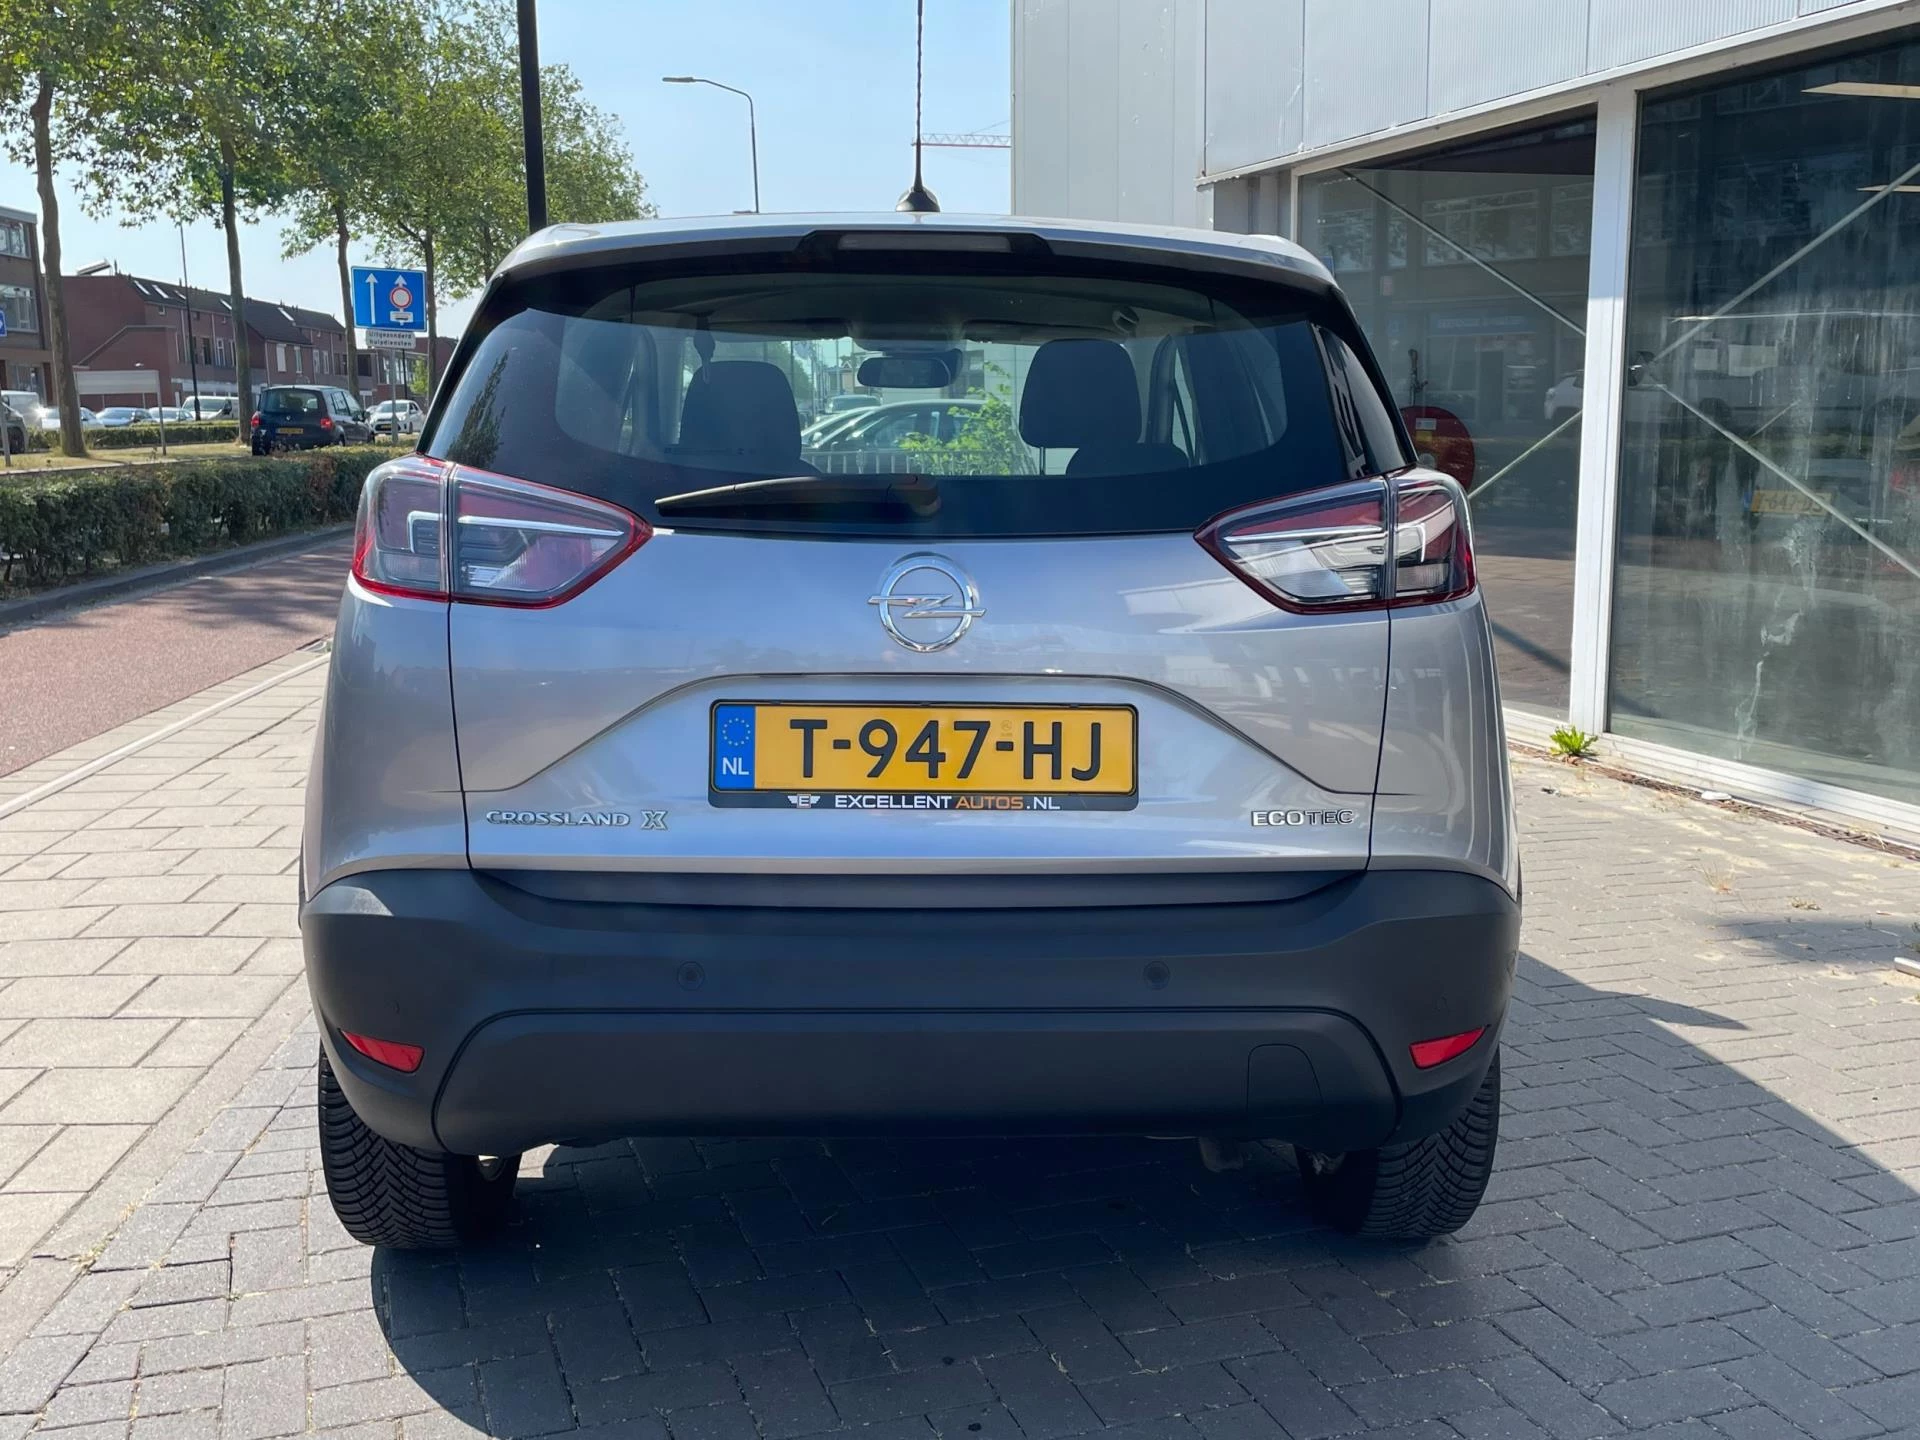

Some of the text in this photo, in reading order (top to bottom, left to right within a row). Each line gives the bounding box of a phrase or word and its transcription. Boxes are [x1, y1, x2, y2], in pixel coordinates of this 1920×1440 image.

[790, 719, 1101, 781] T-947-HJ
[722, 757, 749, 775] NL
[486, 810, 668, 830] CROSSLAND X
[1251, 809, 1354, 826] ECOTEC
